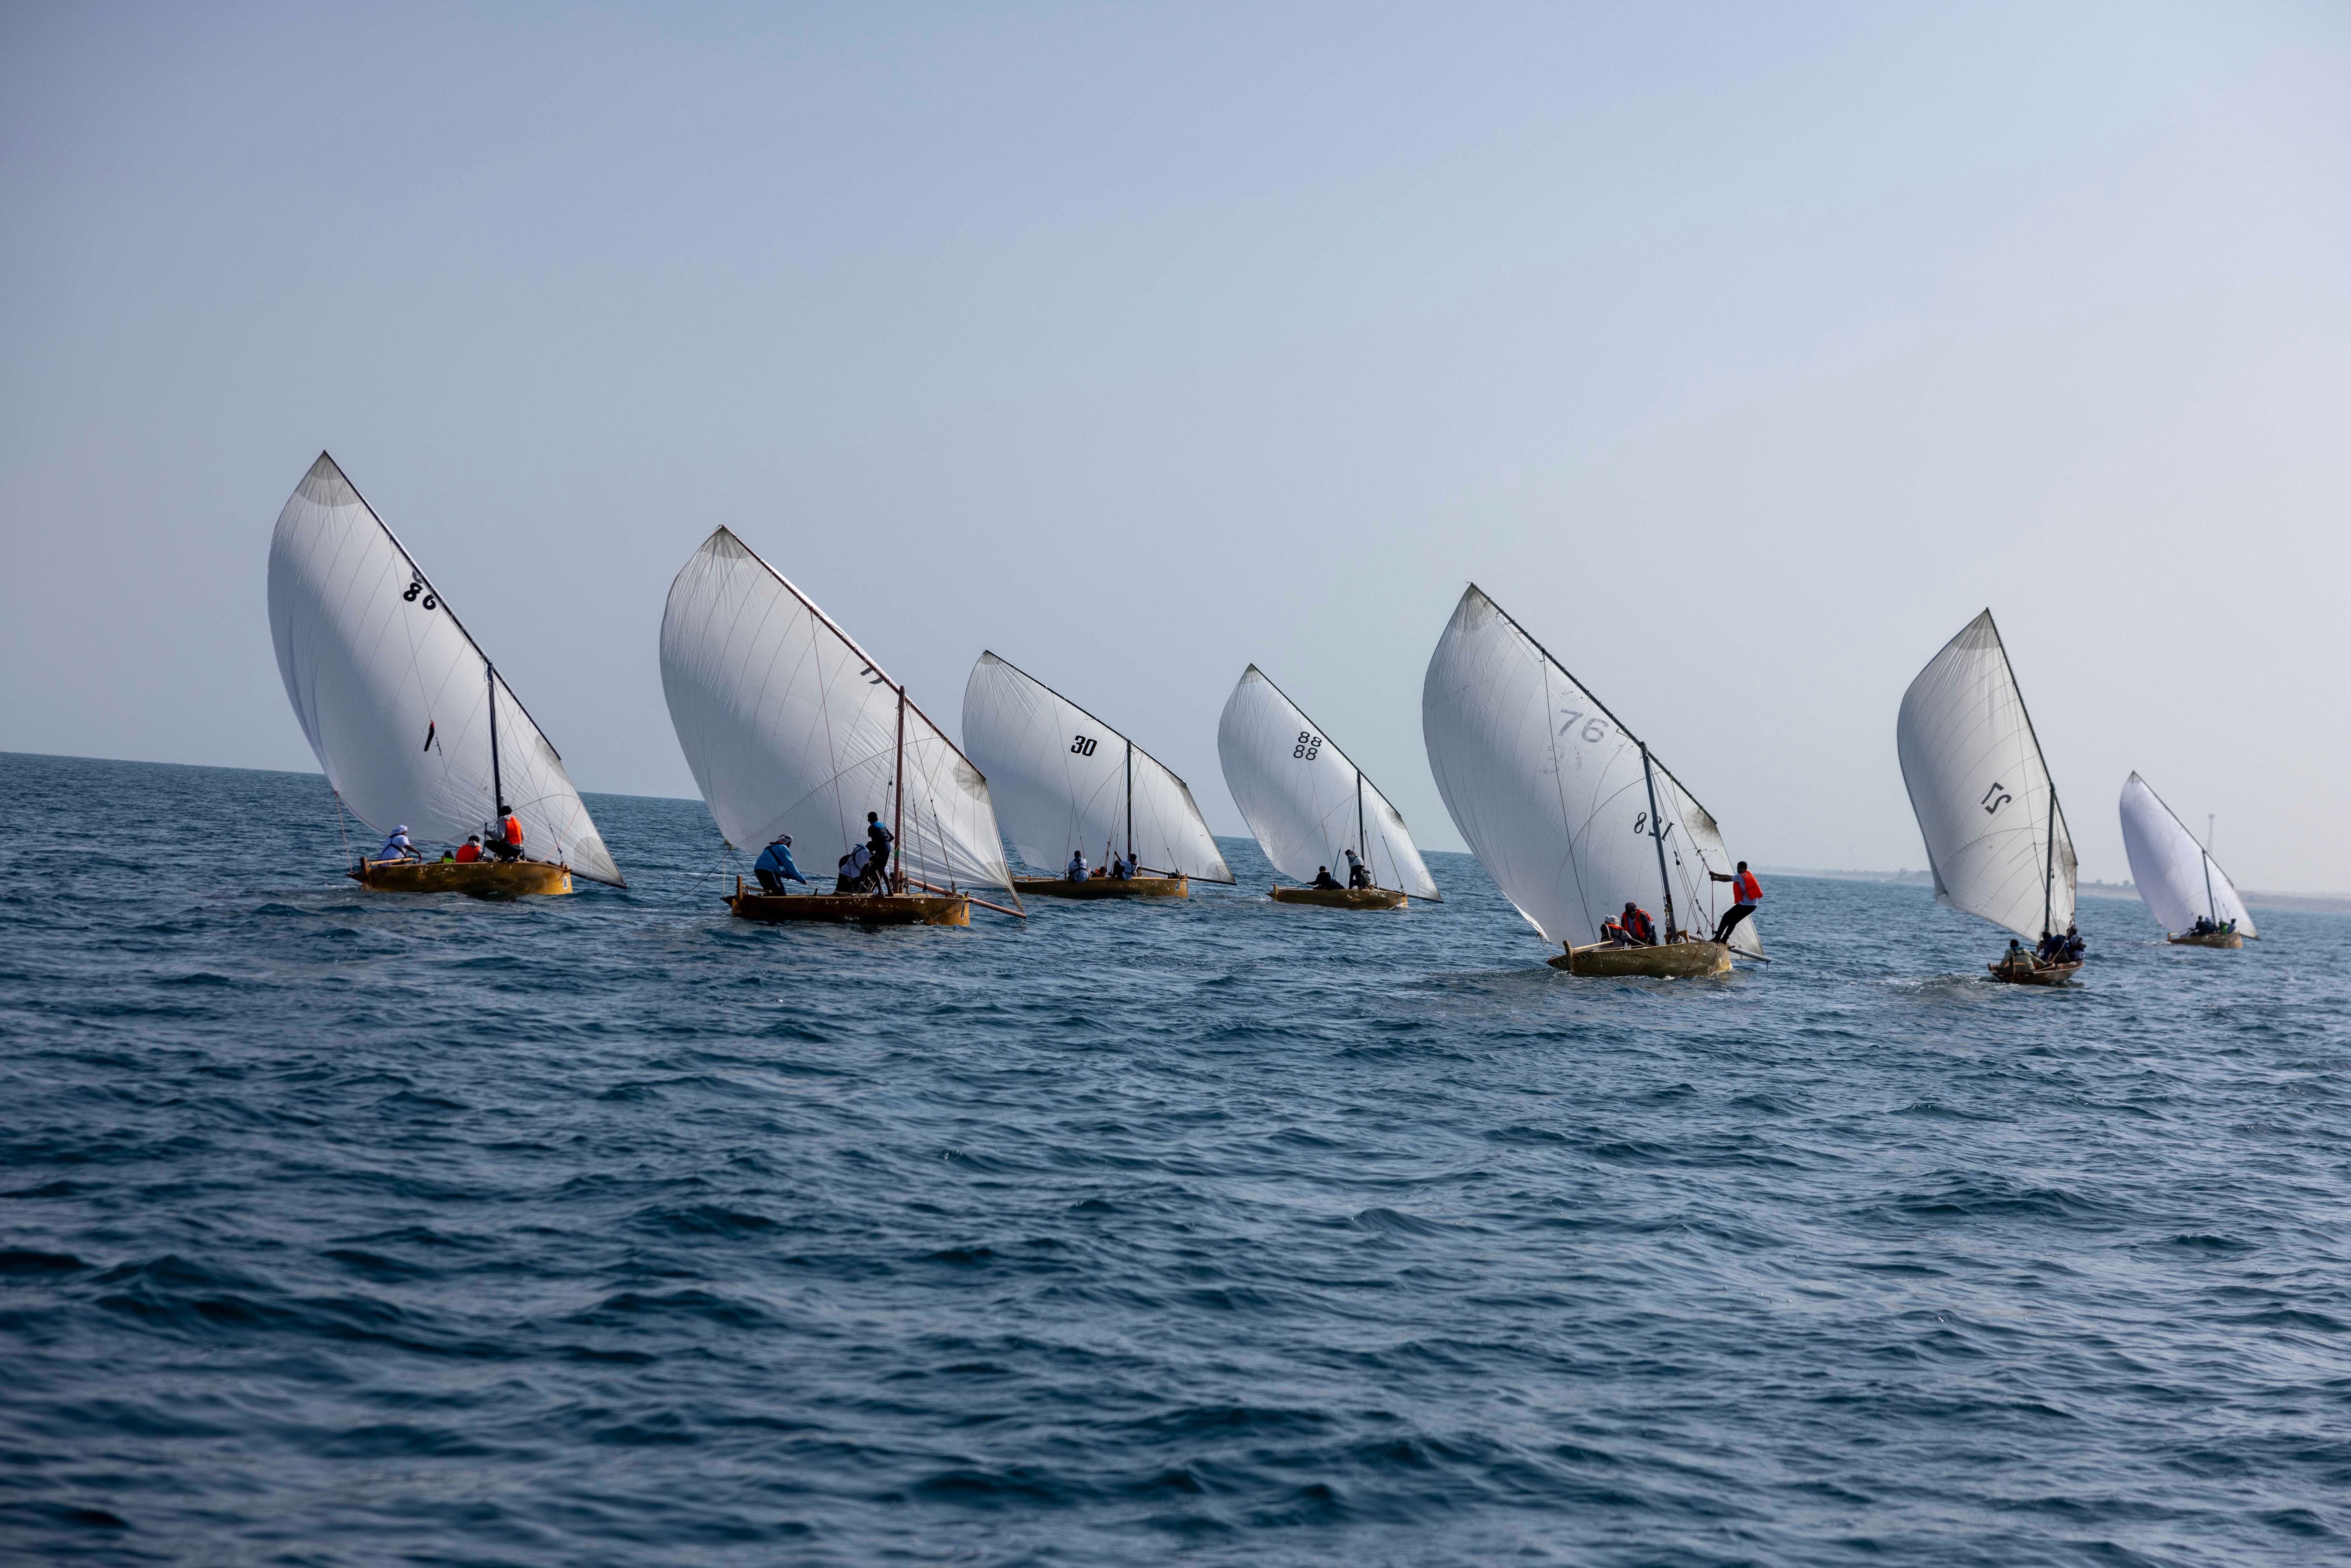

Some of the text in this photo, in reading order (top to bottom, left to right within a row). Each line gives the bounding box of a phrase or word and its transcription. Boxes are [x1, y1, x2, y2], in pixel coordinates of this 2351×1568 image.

[1558, 709, 1609, 742] 76
[1071, 735, 1097, 756] 30
[1298, 731, 1322, 747] 88
[1293, 745, 1318, 760] 88
